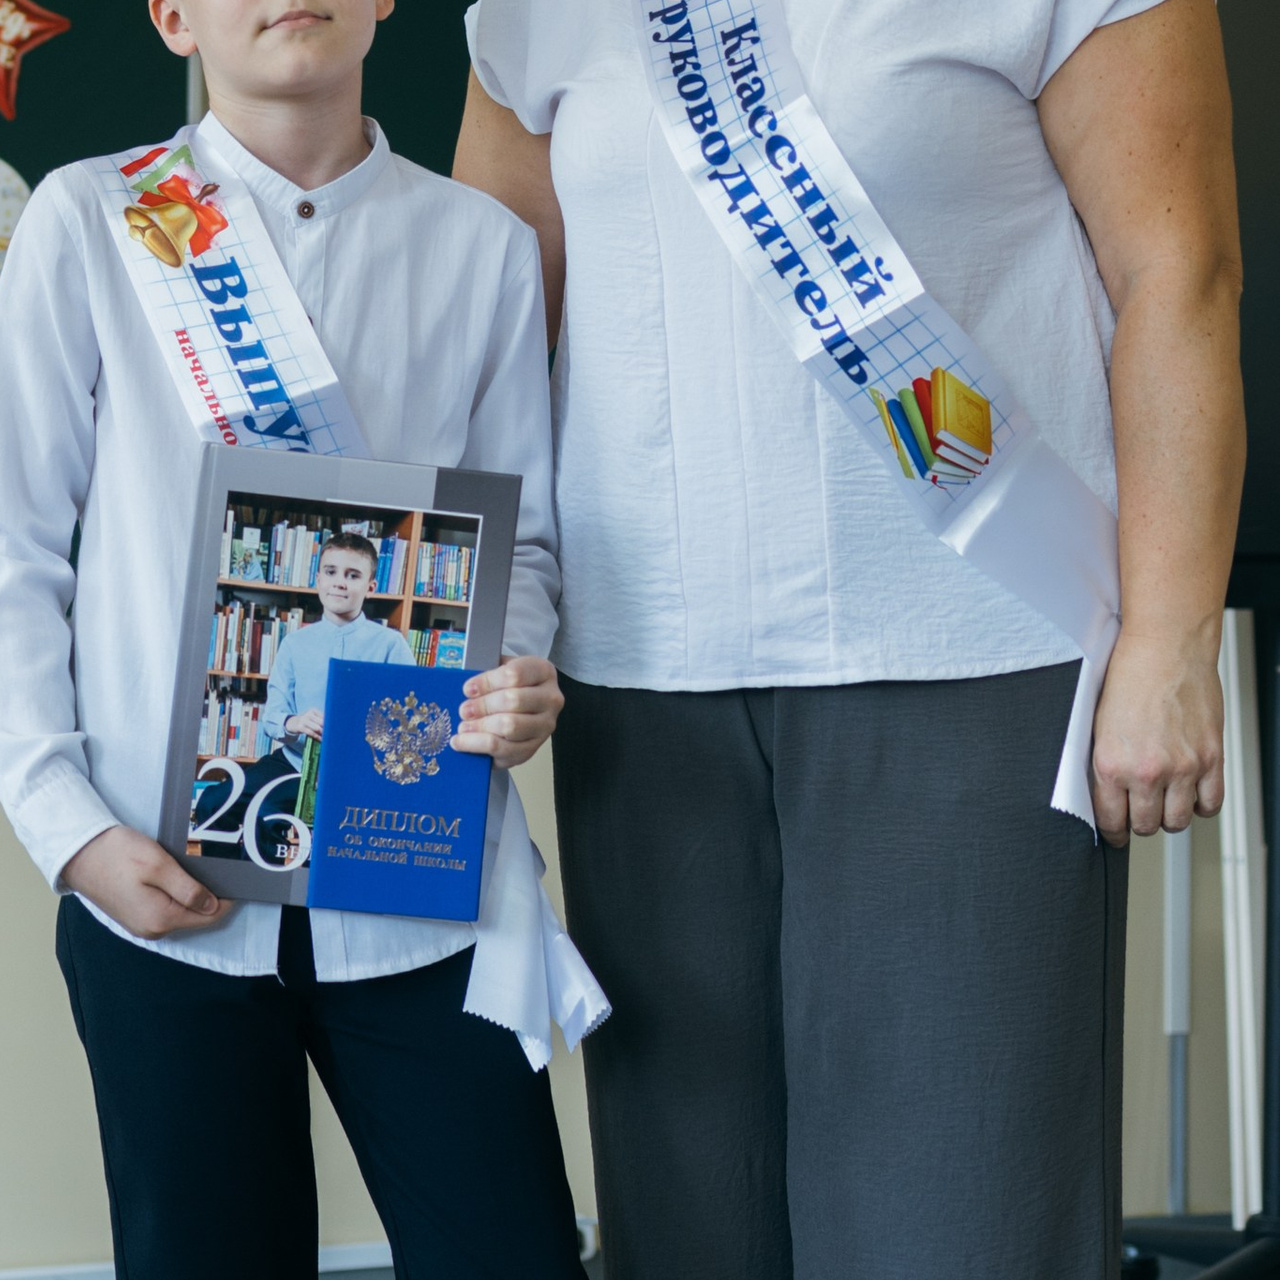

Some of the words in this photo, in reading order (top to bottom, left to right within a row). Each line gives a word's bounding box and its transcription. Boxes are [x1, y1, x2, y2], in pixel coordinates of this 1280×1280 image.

[649, 0, 870, 386] руководитель
[720, 17, 893, 309] Классный
[189, 256, 310, 453] Выпу
[327, 846, 408, 864] НАЧАЛЬНОЙ
[414, 855, 467, 871] ШКОЛЫ
[339, 806, 462, 838] ДИПЛОМ
[344, 833, 362, 845] ОБ
[368, 836, 452, 855] ОКОНЧАНИИ
